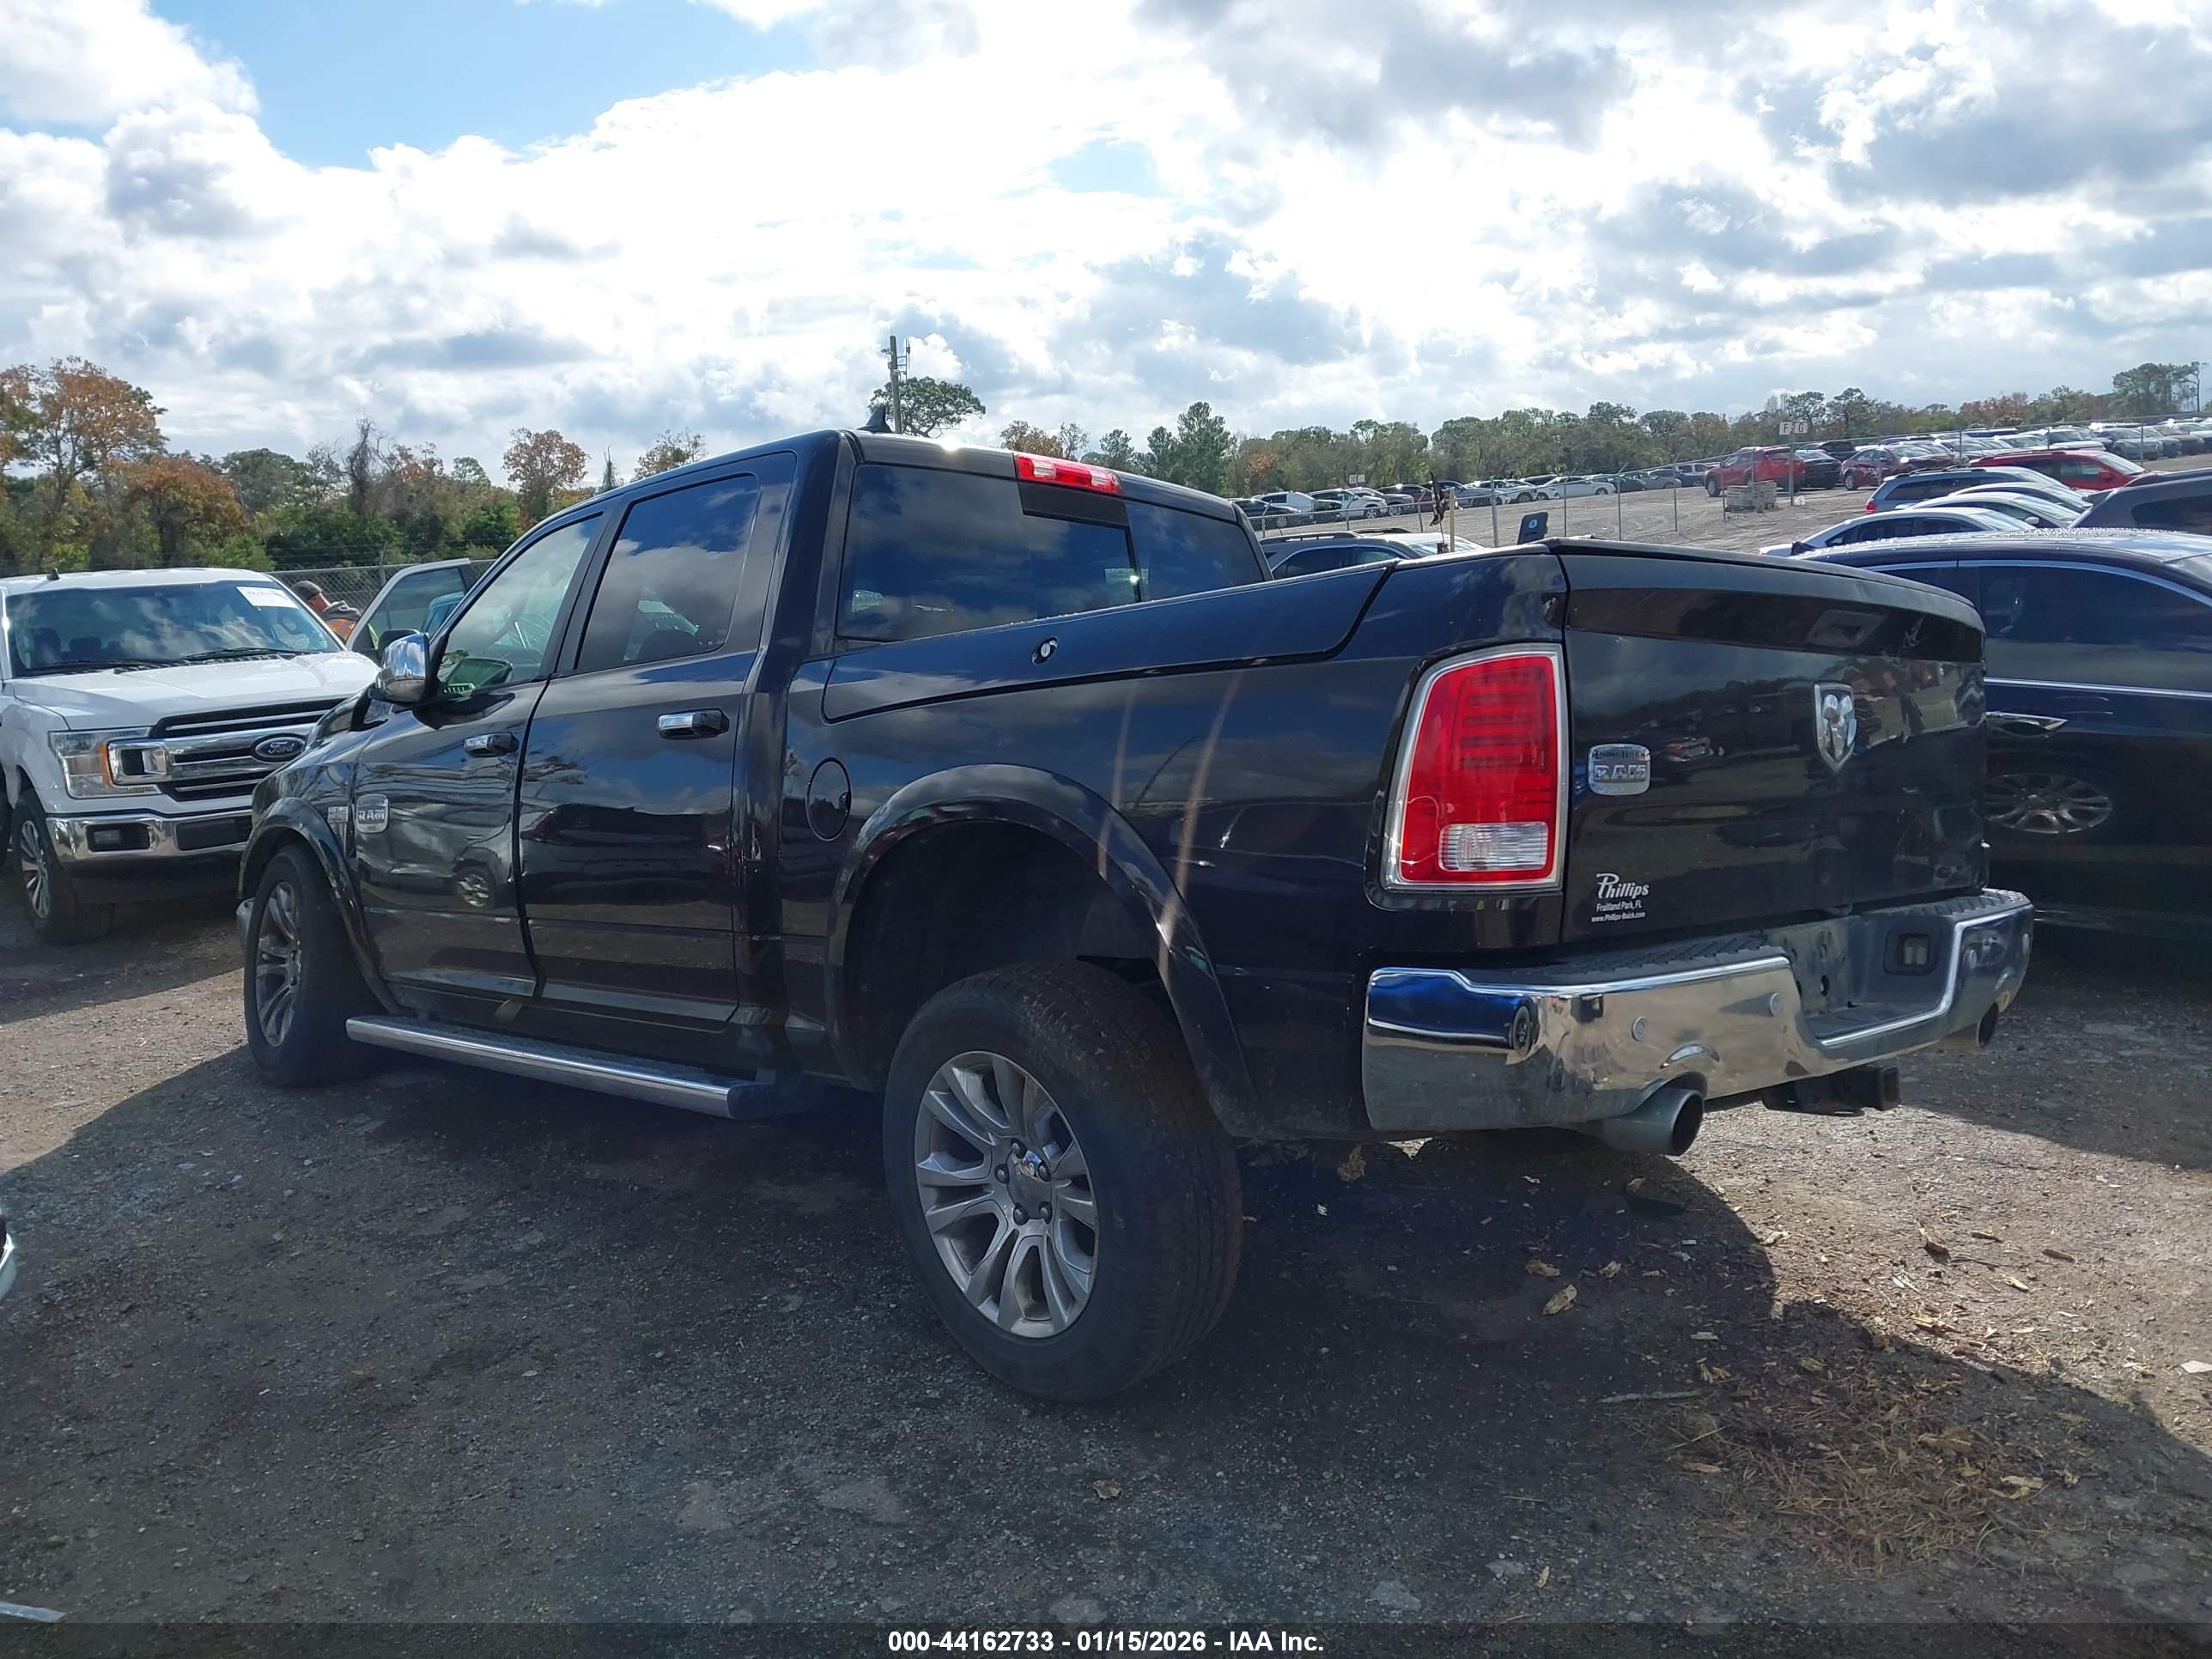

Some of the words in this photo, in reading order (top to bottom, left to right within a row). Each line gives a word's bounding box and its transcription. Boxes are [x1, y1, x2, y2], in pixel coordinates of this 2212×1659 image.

[267, 741, 295, 754] Ford
[358, 809, 386, 821] RAM
[1596, 873, 1649, 899] Phillips
[1596, 902, 1620, 912] Fruitland
